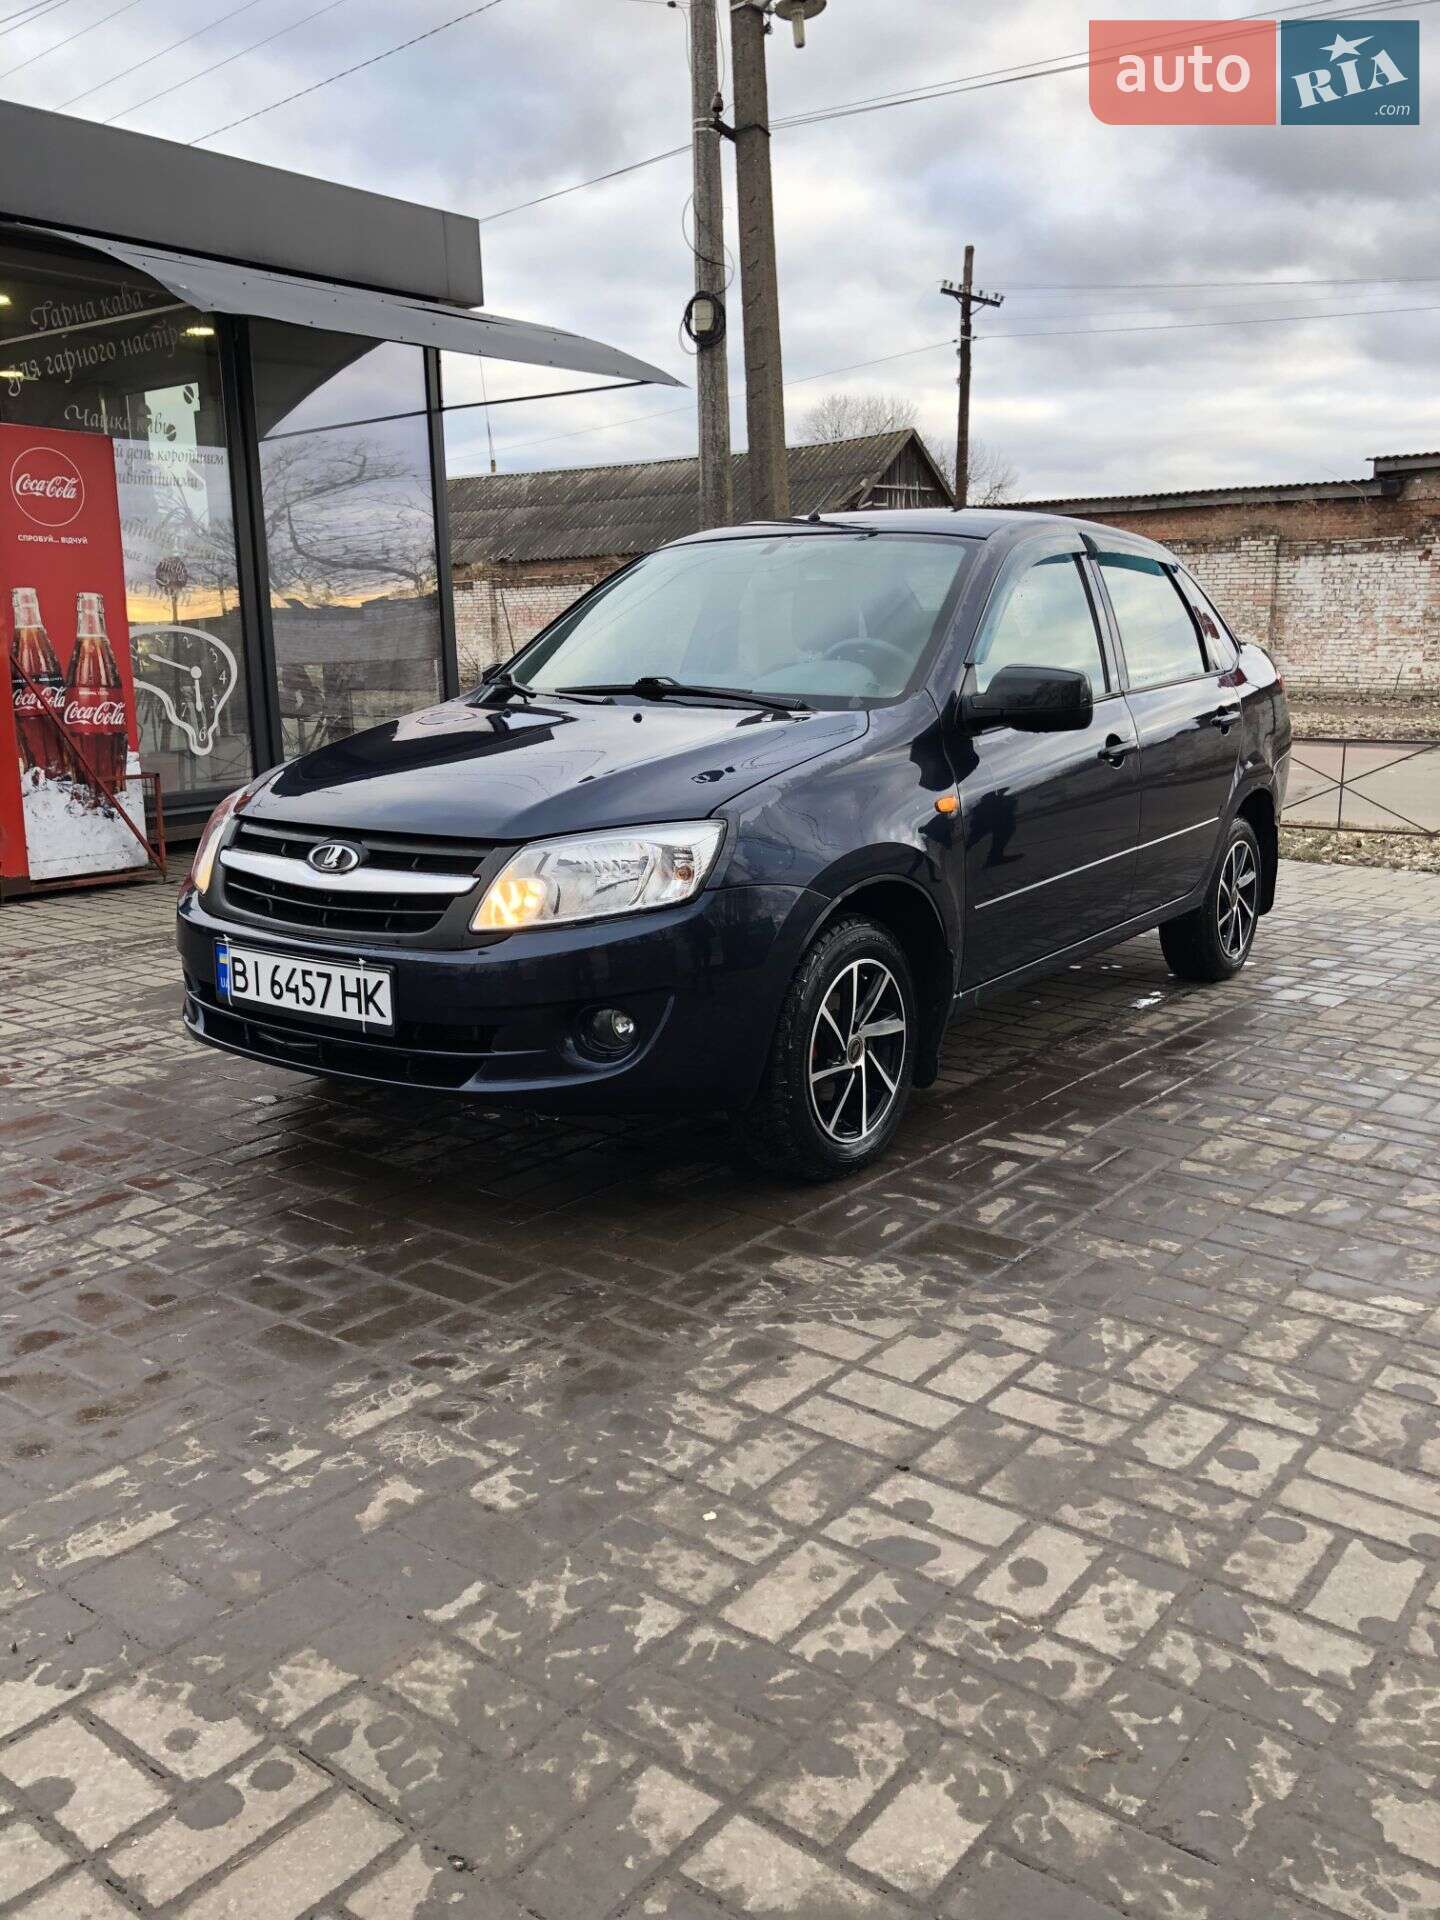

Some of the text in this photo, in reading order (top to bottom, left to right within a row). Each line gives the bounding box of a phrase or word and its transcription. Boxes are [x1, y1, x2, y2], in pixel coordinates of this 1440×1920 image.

[30, 299, 96, 338] Гарна
[101, 281, 144, 317] кава
[46, 340, 117, 384] гарного
[219, 670, 228, 685] 4
[231, 956, 387, 1018] BI 6457 HK
